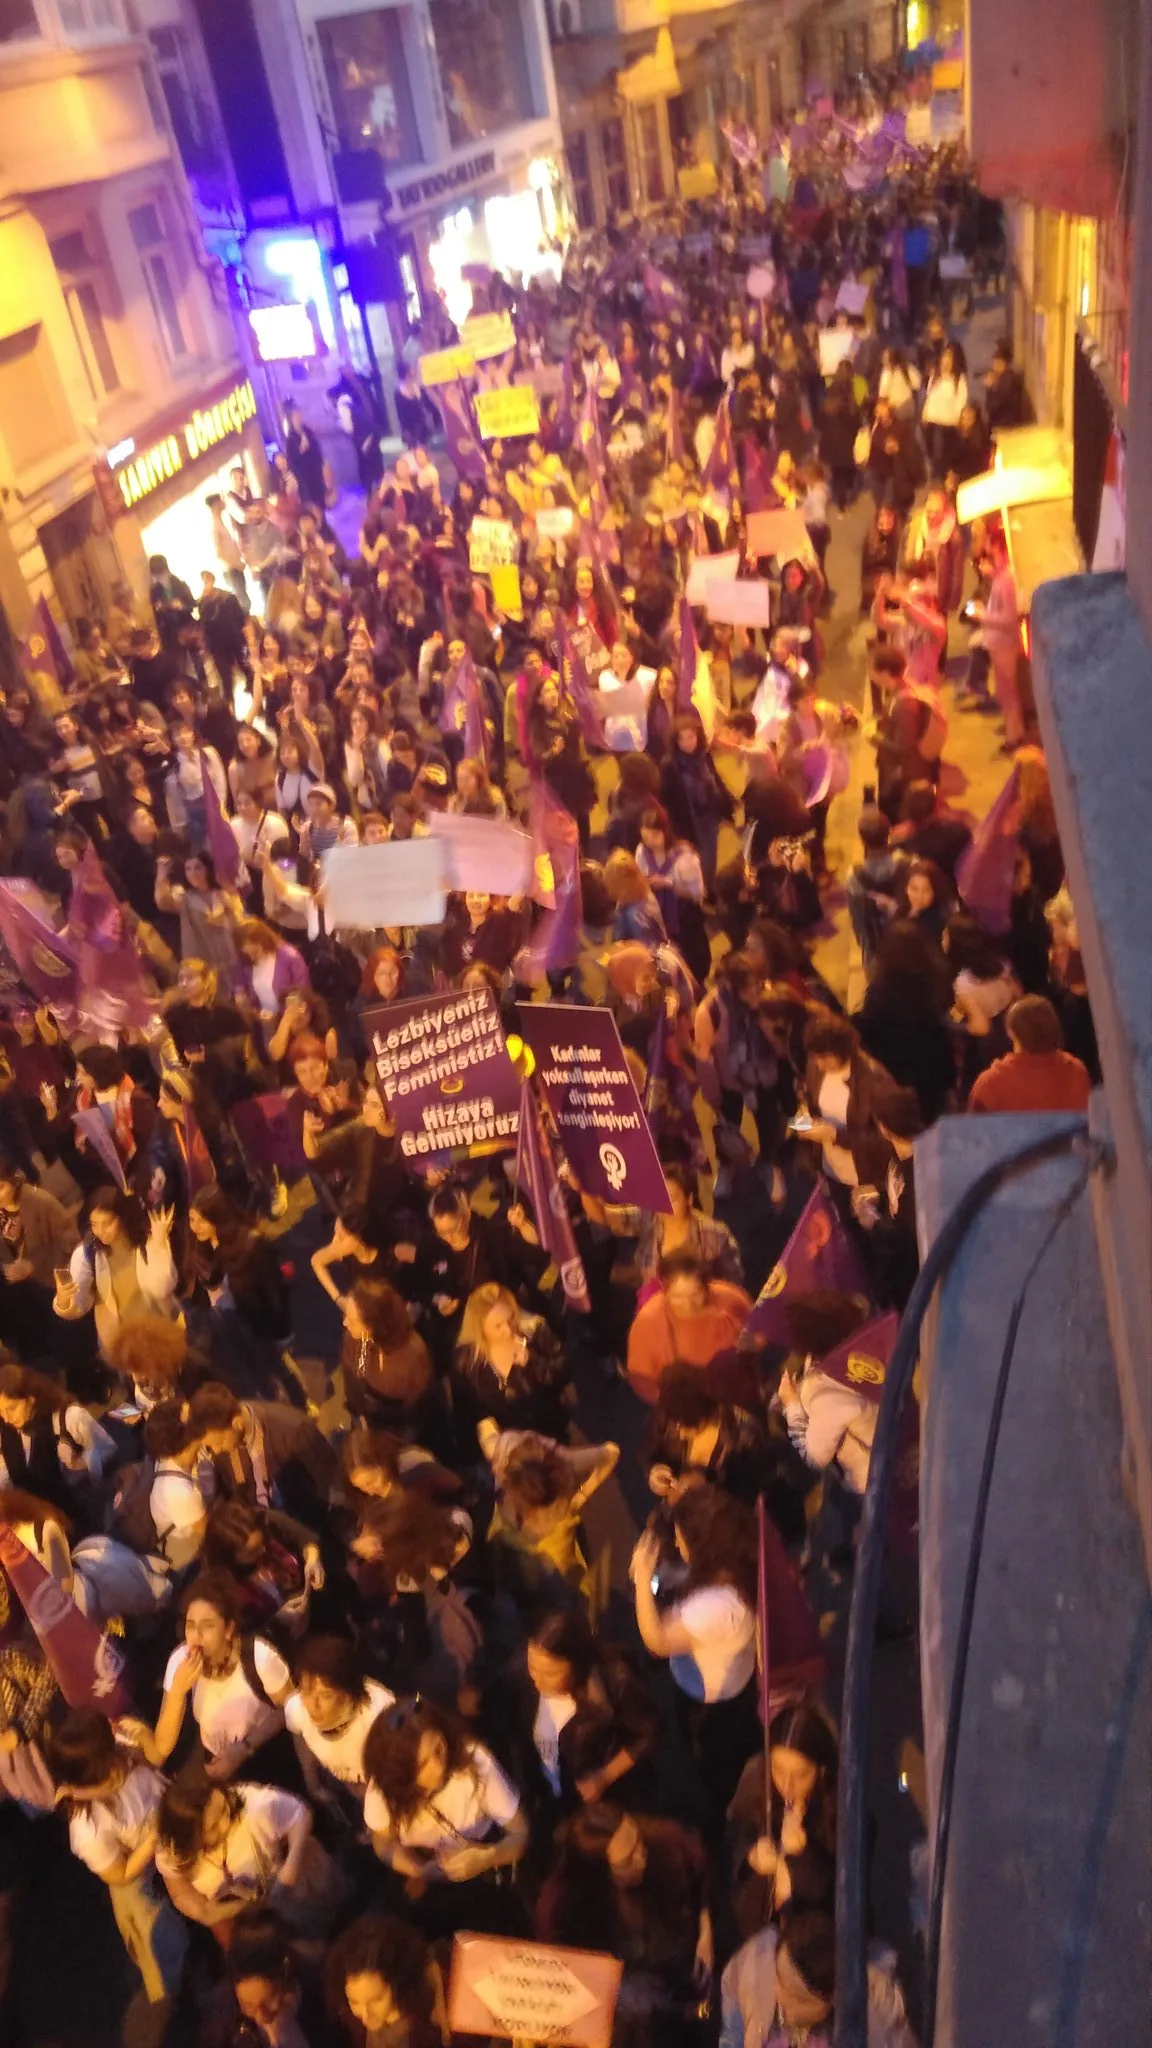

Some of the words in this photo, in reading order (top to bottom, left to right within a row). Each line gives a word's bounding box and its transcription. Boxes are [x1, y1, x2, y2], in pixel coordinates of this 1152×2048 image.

[372, 990, 489, 1055] Lezbiyeniz
[376, 1012, 499, 1079] Biseksüeliz
[383, 1031, 504, 1102] Feministiz!
[569, 1088, 615, 1109] diyanet
[400, 1112, 520, 1157] Gelmiyoruz
